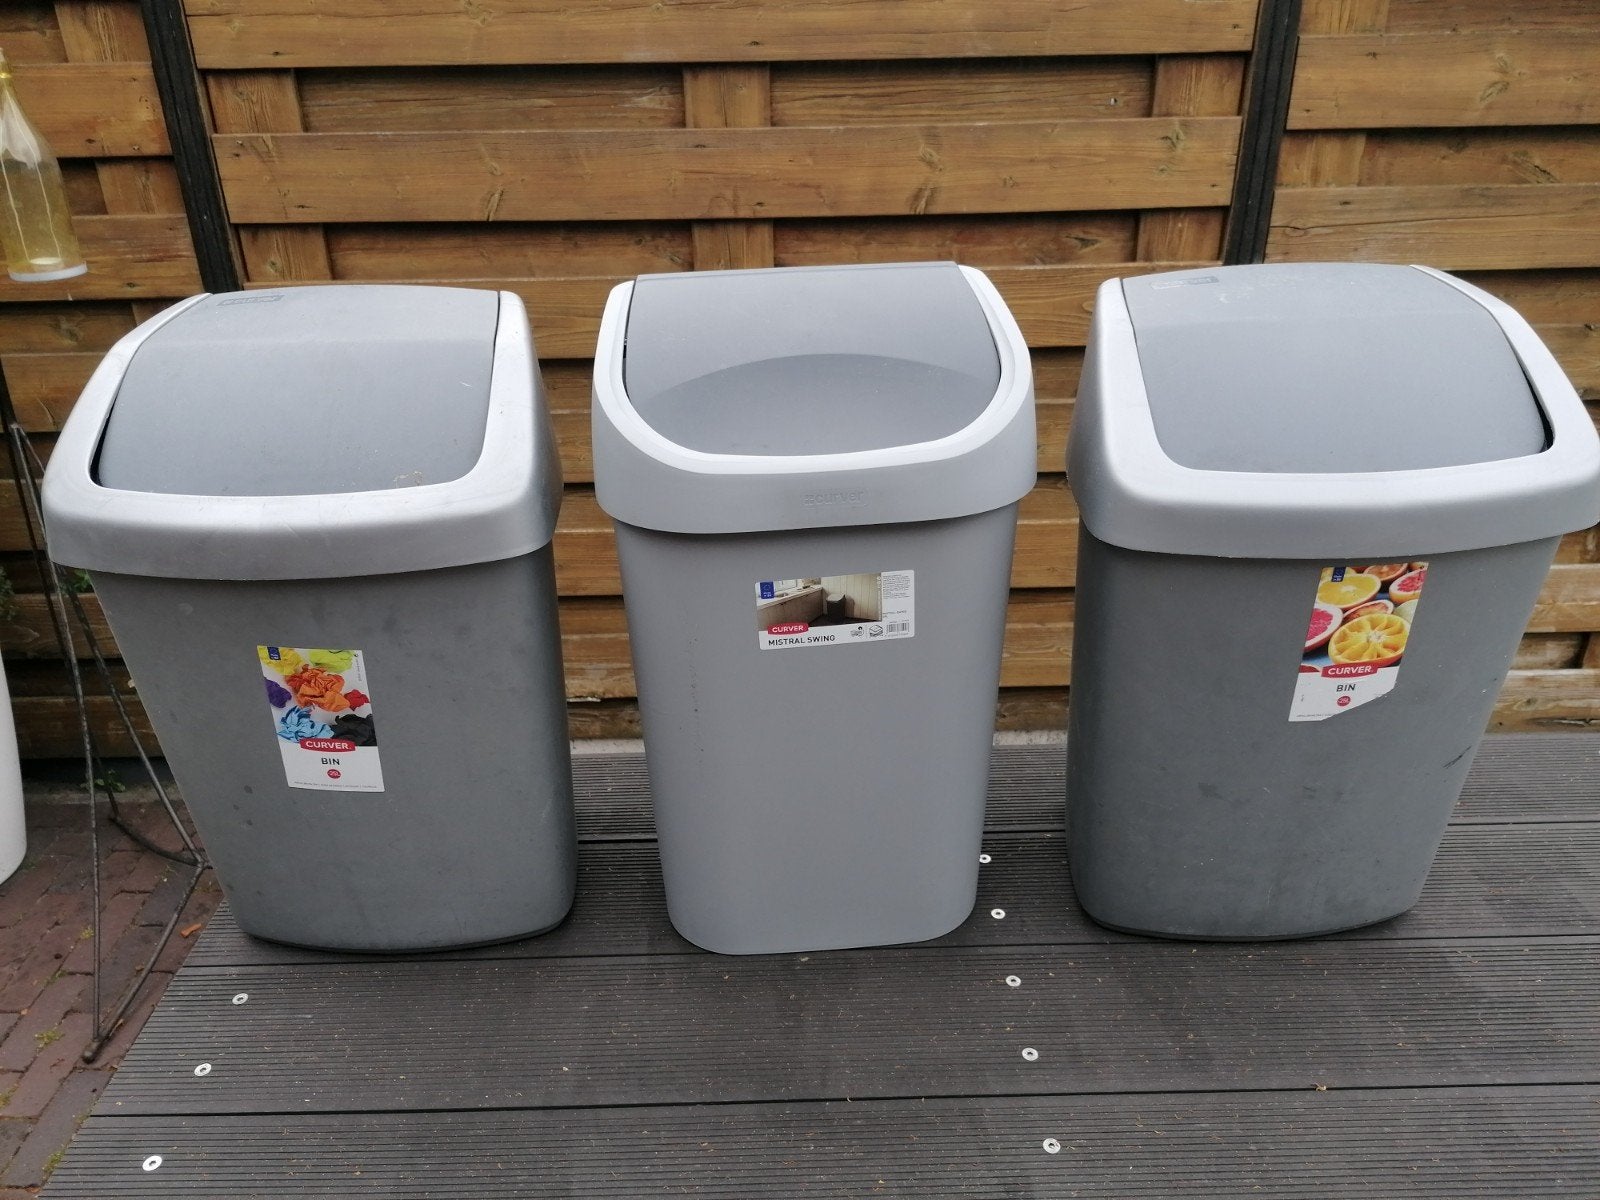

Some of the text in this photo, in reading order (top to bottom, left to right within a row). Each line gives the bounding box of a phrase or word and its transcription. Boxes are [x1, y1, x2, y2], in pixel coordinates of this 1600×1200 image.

[771, 624, 804, 634] CURVER
[768, 635, 836, 647] MISTRAL SWING
[1327, 665, 1373, 675] CURVER
[1336, 683, 1356, 692] BIN
[305, 740, 349, 750] CURVER
[321, 757, 340, 765] BIN
